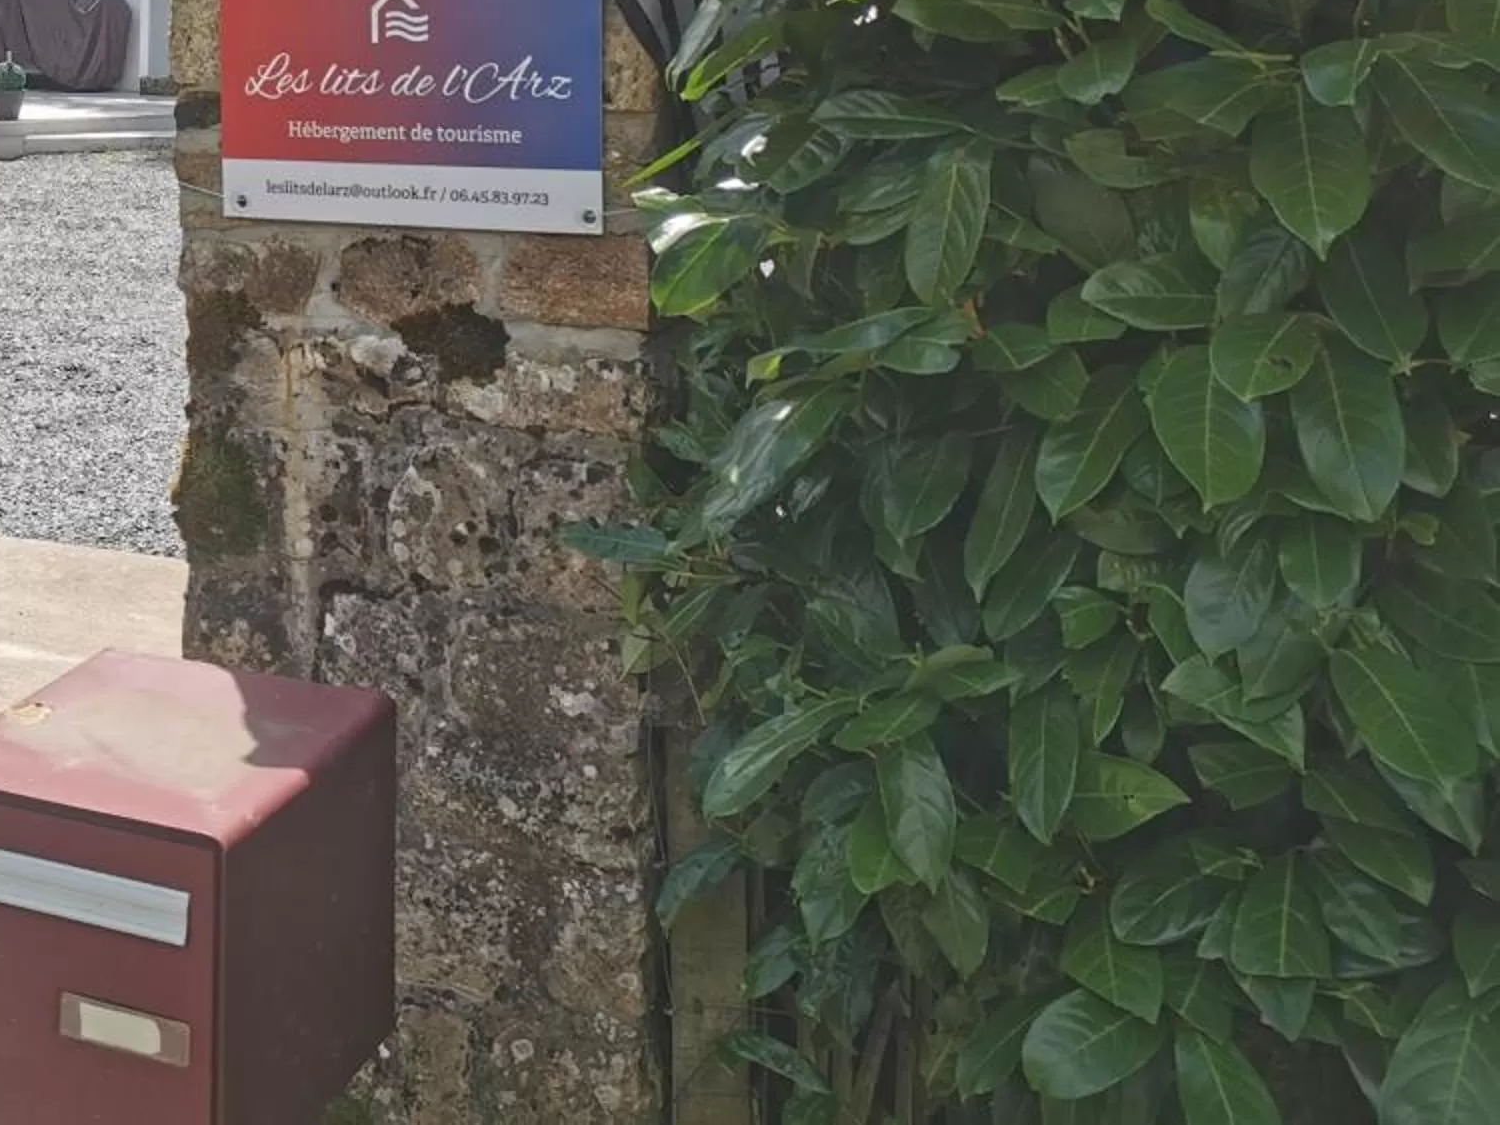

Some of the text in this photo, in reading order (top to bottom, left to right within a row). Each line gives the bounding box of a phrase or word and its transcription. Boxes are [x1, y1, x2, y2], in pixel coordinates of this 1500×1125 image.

[245, 52, 573, 104] Les lits de l'Arz
[287, 120, 523, 145] Hébergement de tourisme
[265, 178, 437, 201] leslitsdelarz@outlook.fr
[449, 188, 549, 206] 06.45.83.97.23
